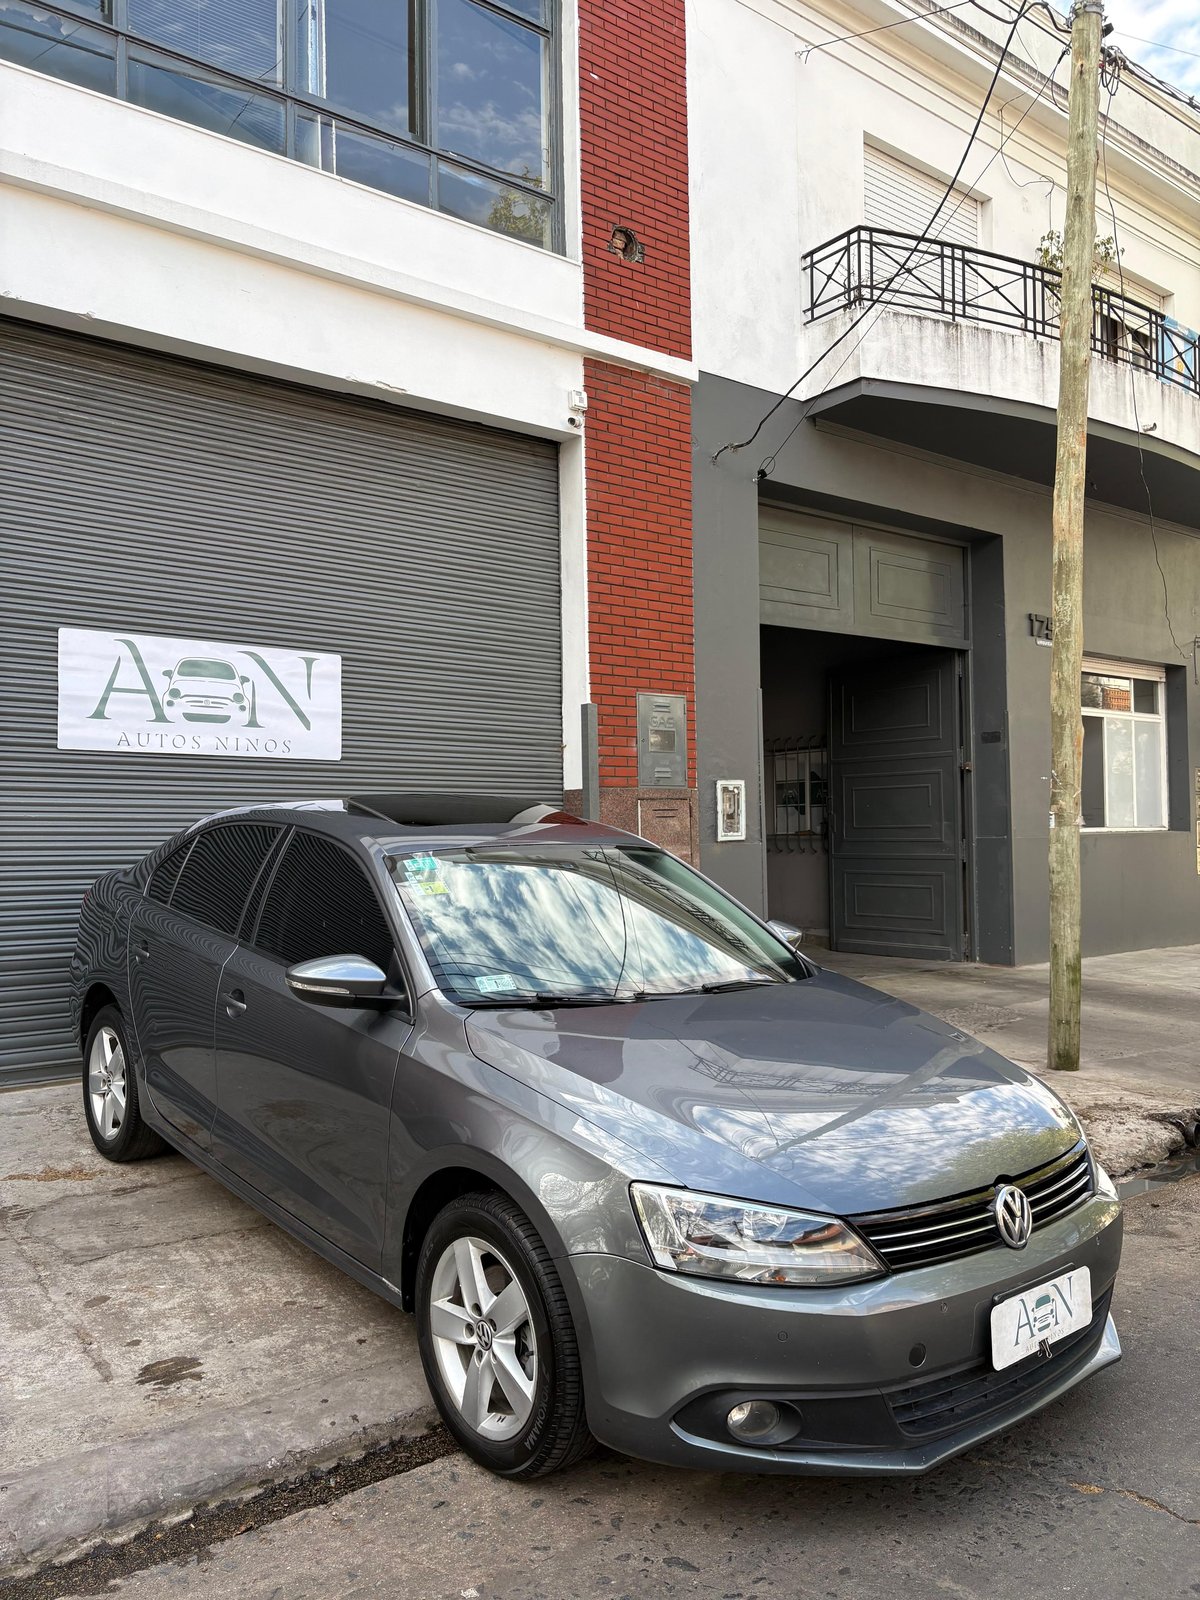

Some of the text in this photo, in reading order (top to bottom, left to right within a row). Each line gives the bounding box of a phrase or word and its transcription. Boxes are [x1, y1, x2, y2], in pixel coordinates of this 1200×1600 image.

[650, 715, 674, 728] GAS
[117, 731, 291, 754] AUTOS NINOS
